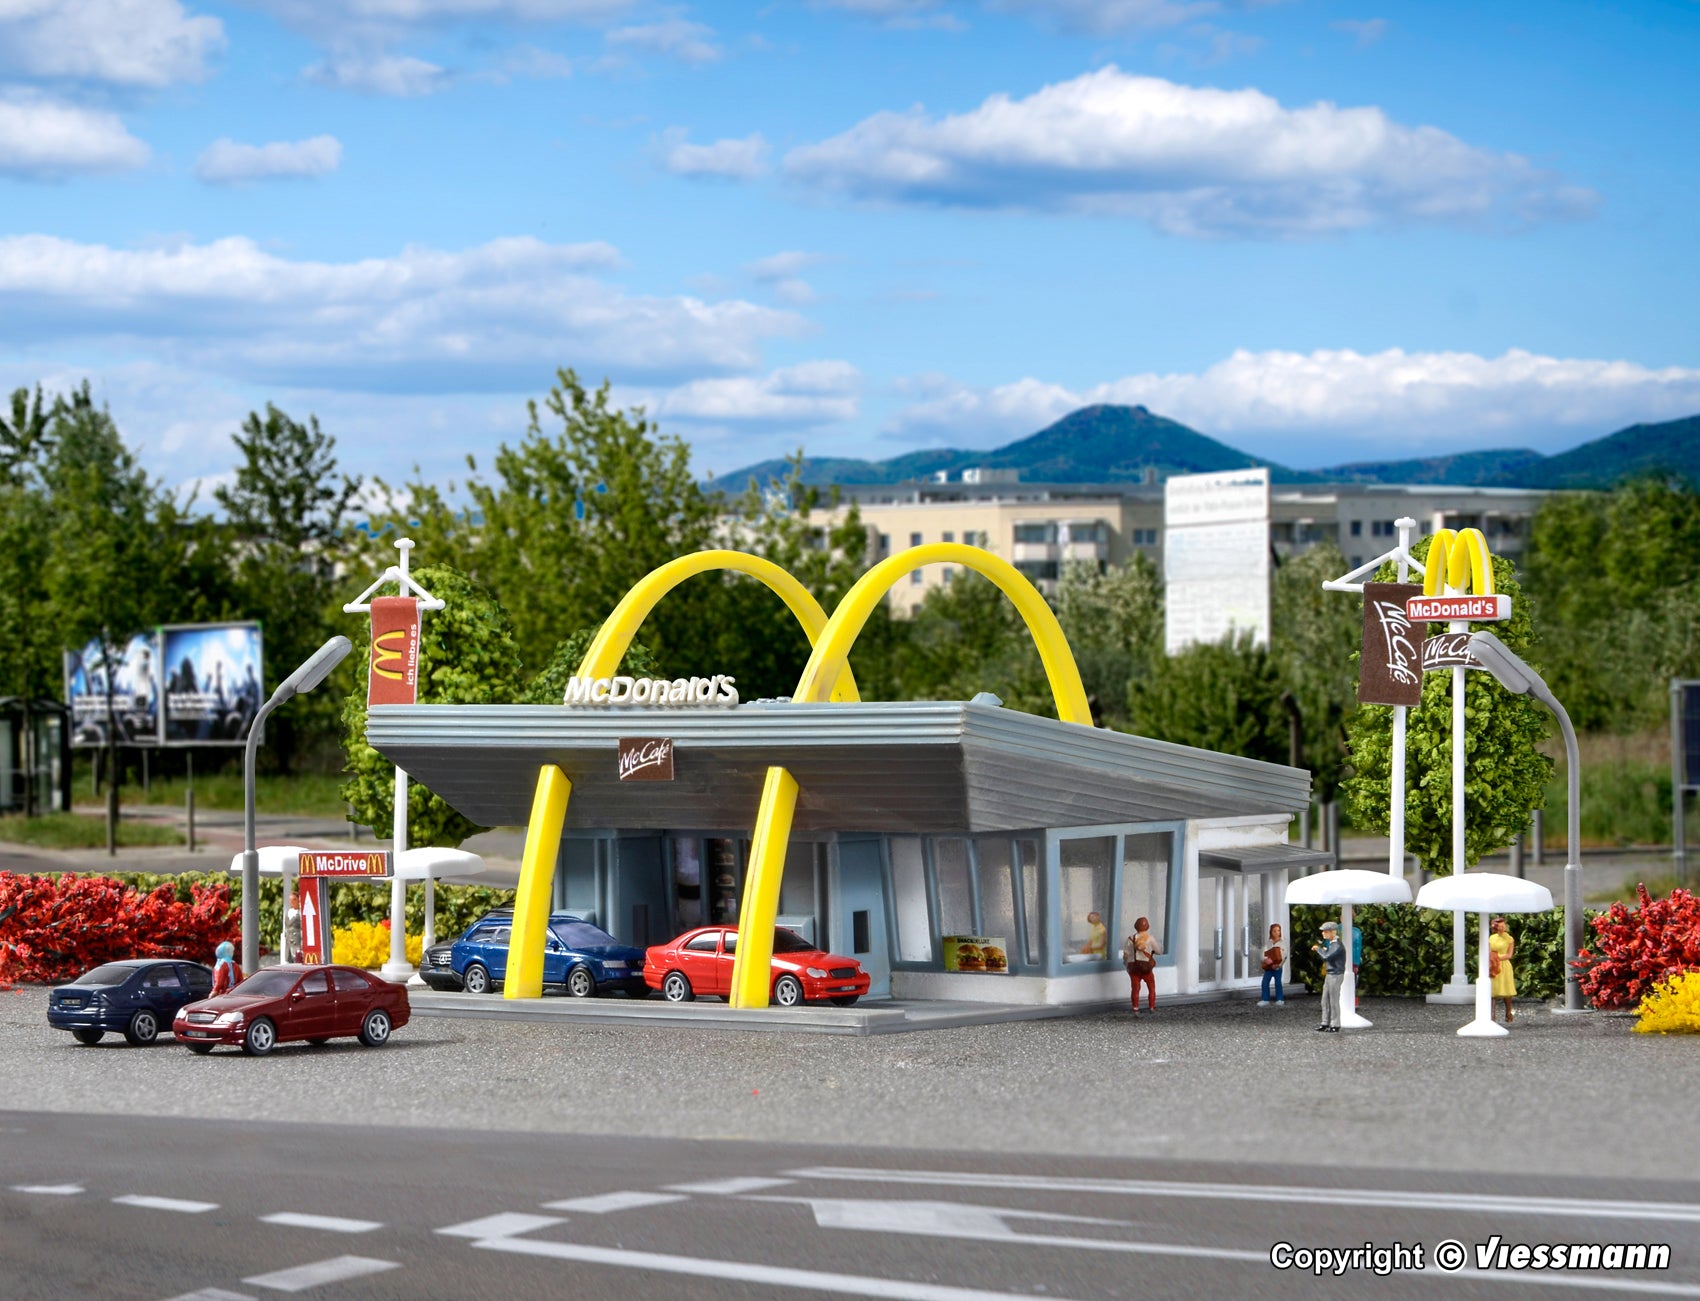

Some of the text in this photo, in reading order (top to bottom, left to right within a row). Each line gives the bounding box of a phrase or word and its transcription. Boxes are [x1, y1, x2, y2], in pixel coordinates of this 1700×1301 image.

[1409, 600, 1494, 618] McDonald's
[406, 623, 417, 685] ich liebe es
[1379, 601, 1418, 685] McCafé
[1424, 634, 1475, 664] McCa
[563, 674, 739, 706] McDonald's
[619, 738, 670, 774] McCafé
[316, 856, 367, 871] McDrive
